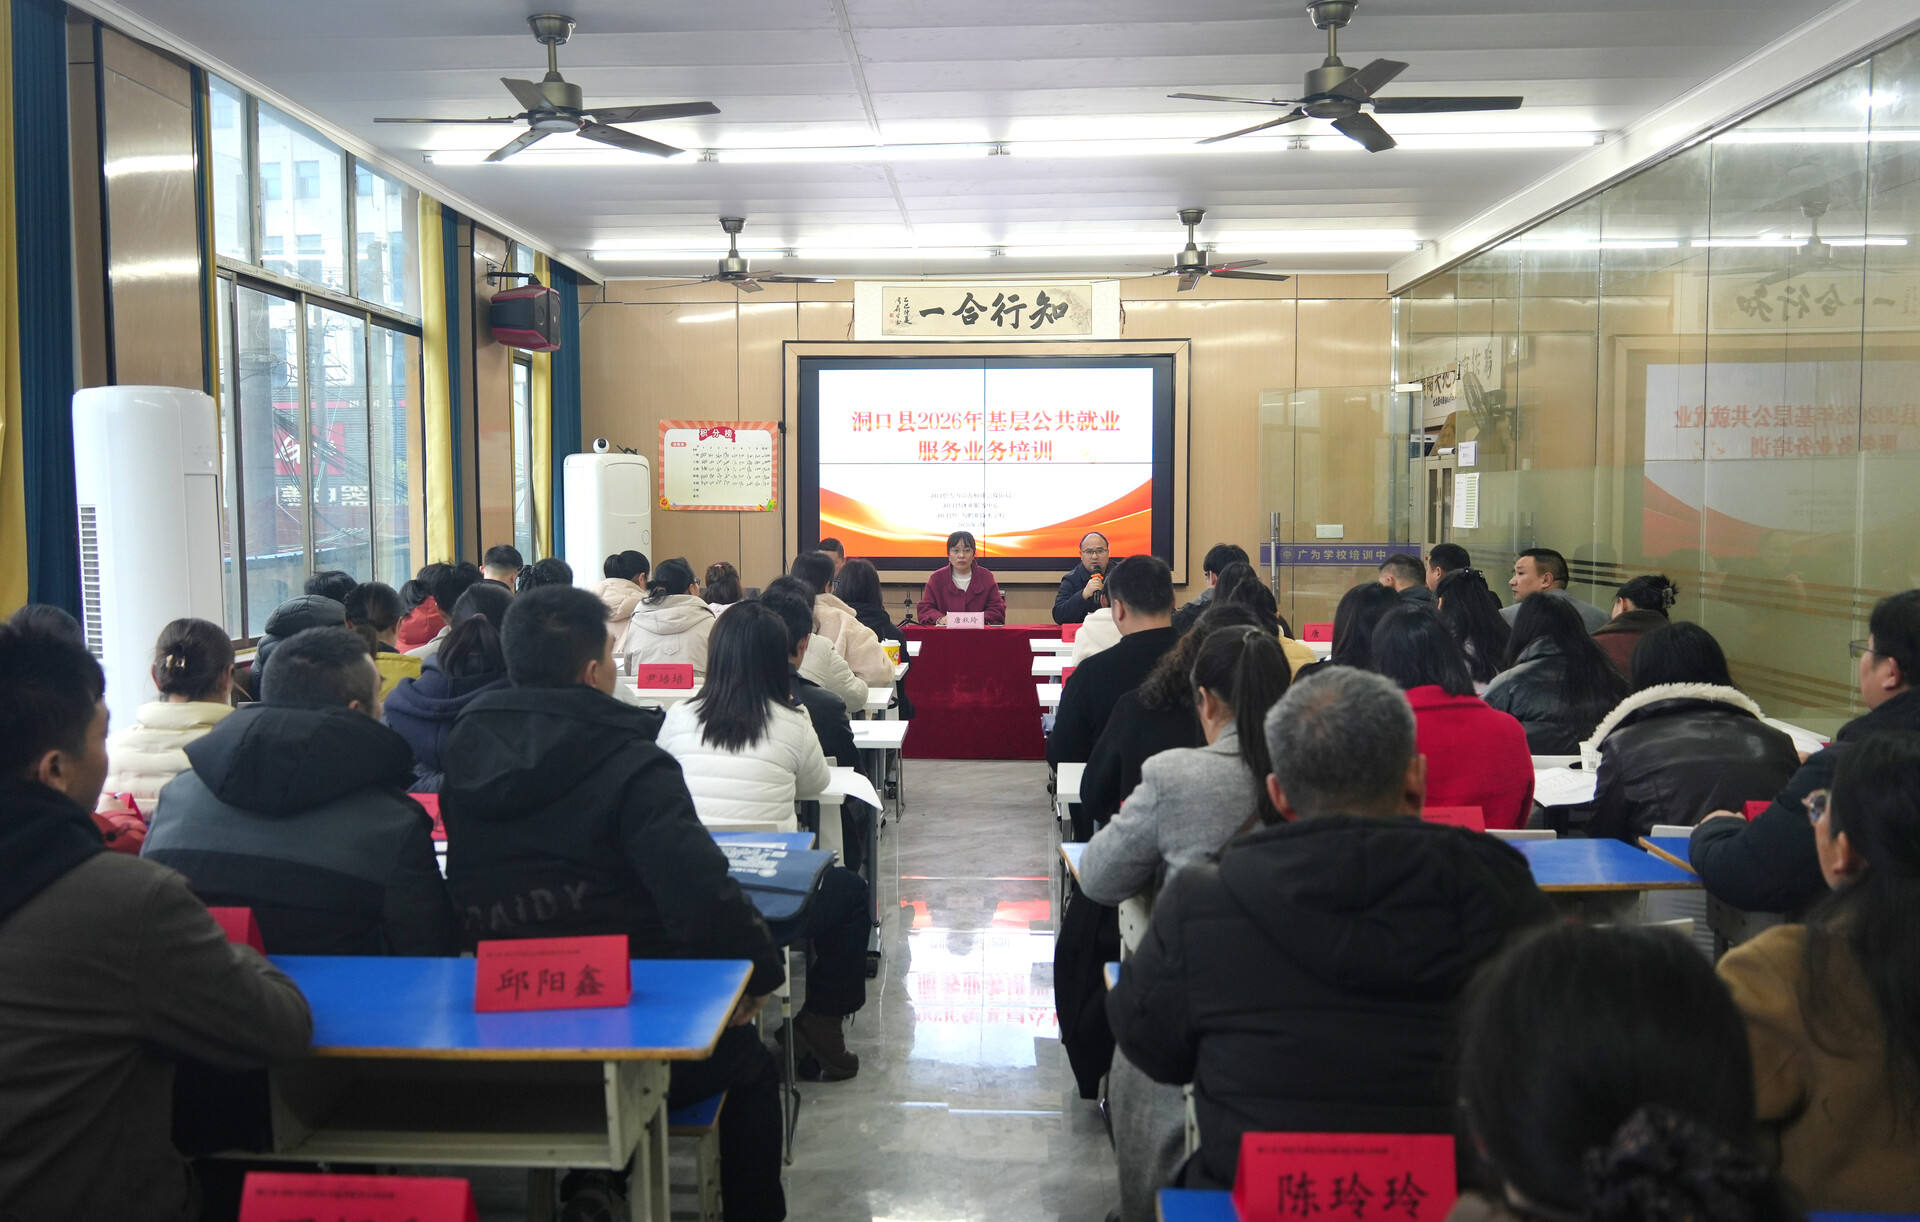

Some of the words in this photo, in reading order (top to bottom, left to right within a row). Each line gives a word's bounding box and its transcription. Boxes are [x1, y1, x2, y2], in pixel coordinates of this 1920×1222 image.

[919, 290, 1069, 330] 知行合一
[852, 410, 1121, 432] 洞口县2026年基层公共就业
[918, 440, 1053, 462] 服务业务培训
[496, 963, 606, 1001] 邱阳鑫
[1277, 1170, 1429, 1219] 陈玲玲
